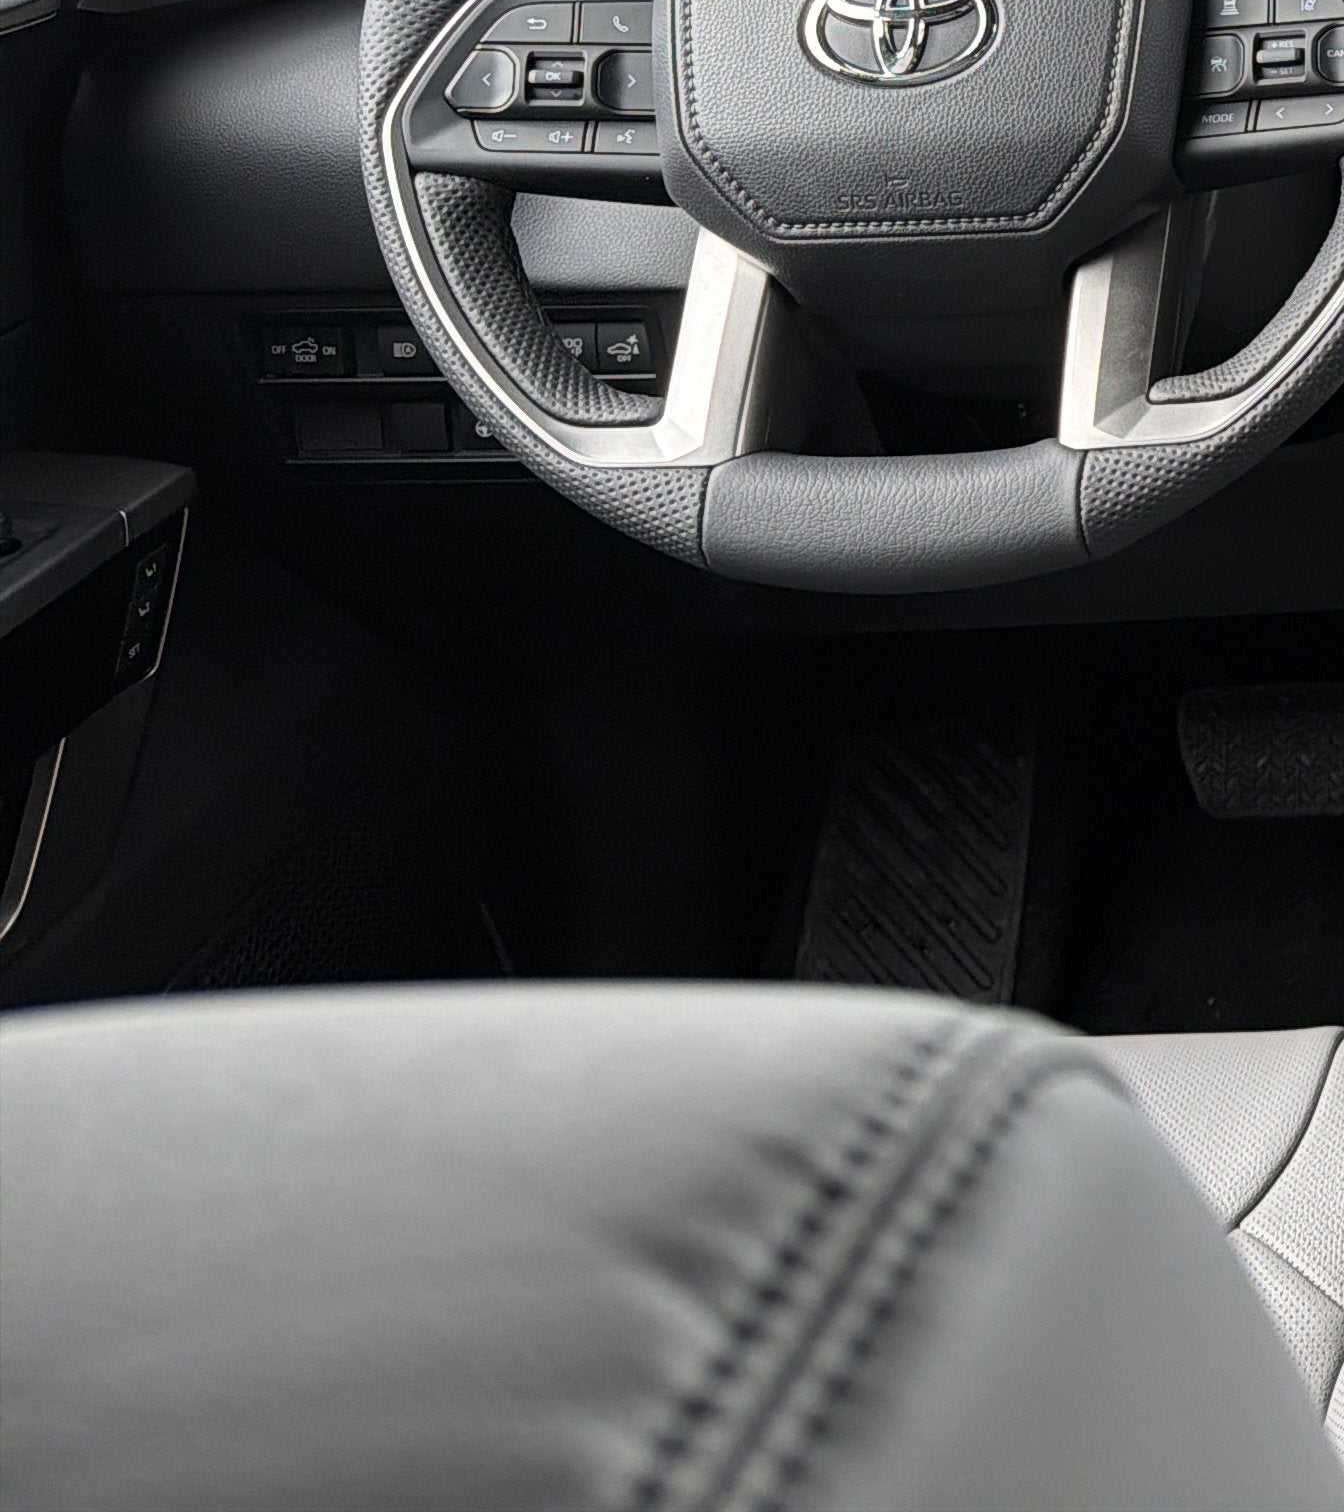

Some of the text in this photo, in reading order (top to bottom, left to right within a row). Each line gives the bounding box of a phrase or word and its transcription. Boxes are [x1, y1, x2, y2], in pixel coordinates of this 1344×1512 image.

[545, 71, 561, 81] OK
[1201, 113, 1235, 124] MODE
[837, 192, 964, 212] SRS AIRBAG
[271, 344, 337, 357] OFF ON
